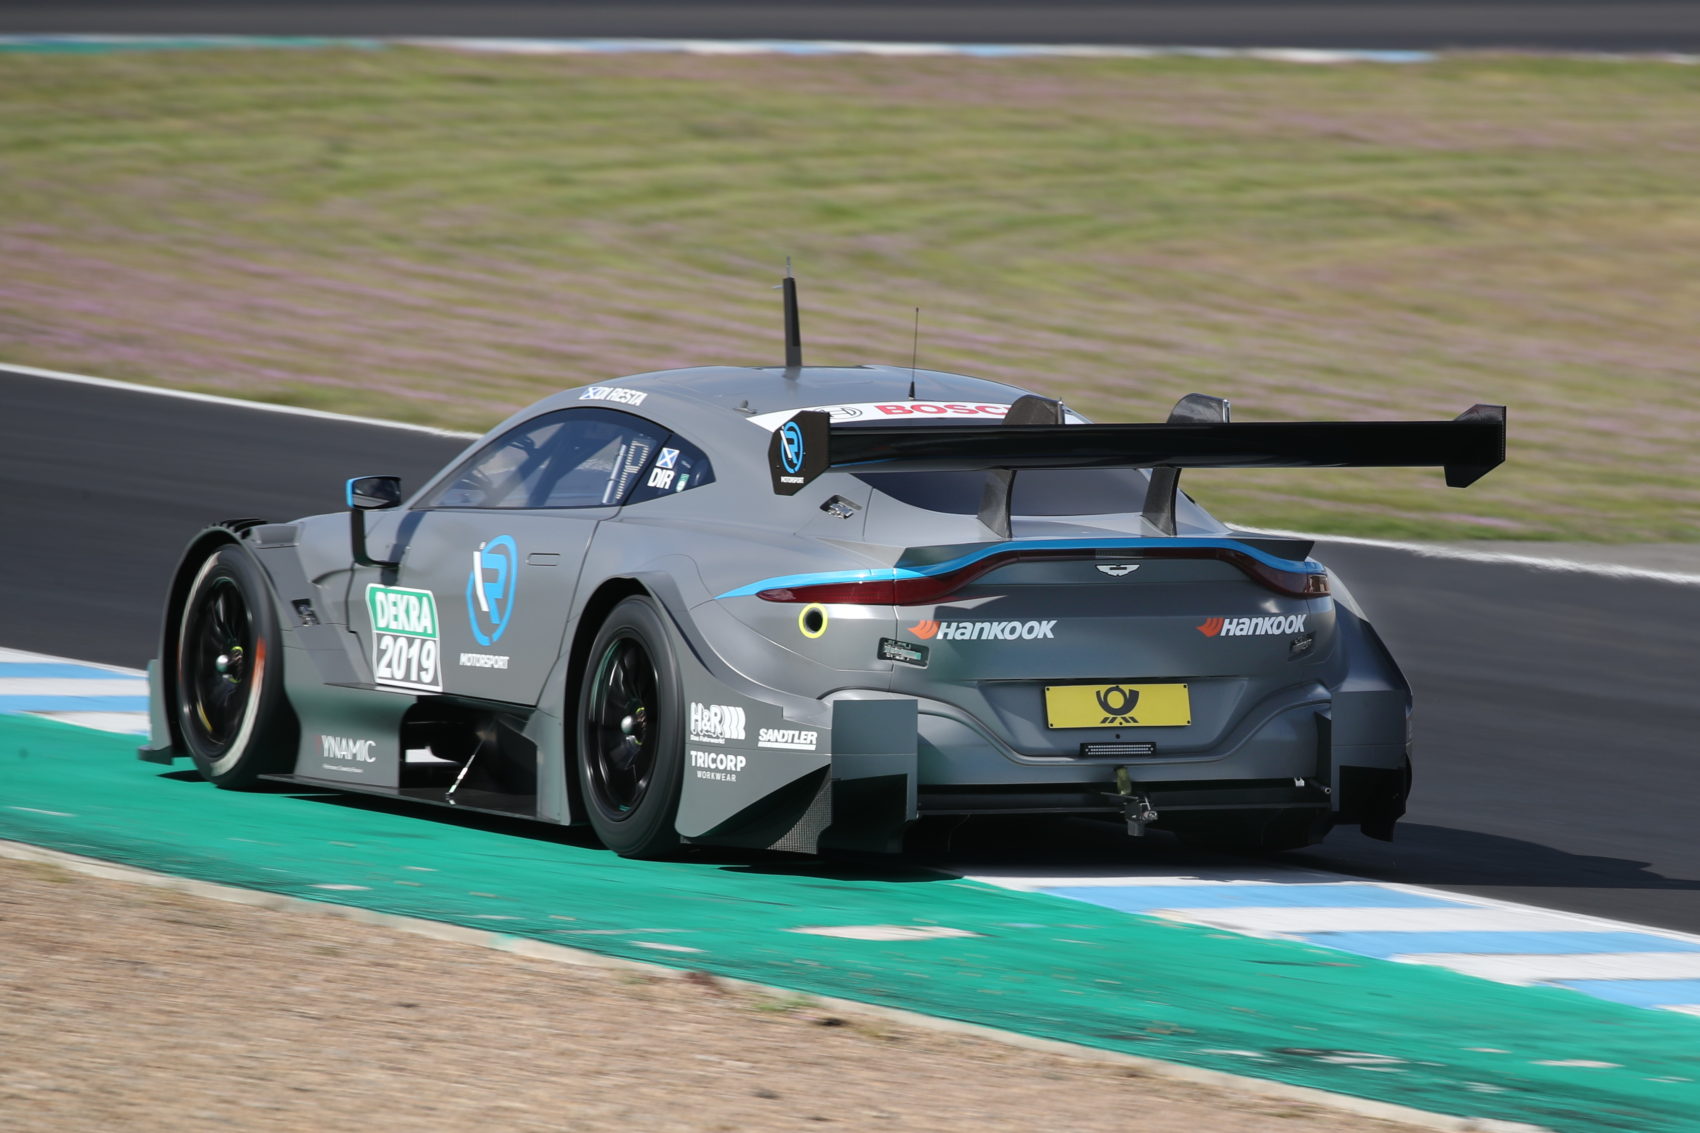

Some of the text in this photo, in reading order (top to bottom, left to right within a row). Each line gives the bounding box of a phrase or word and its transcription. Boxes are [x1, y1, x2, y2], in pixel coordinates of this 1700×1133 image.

[606, 387, 648, 406] RESTA
[874, 404, 1012, 416] BOSC
[647, 467, 675, 489] DIR
[375, 591, 433, 634] DEKRA
[377, 635, 436, 683] 2019
[459, 652, 510, 669] MOTORSPORT
[690, 702, 732, 738] H&R
[758, 728, 818, 745] SANDTLER
[690, 750, 746, 772] TRICORP
[696, 770, 737, 782] WORKWEAR
